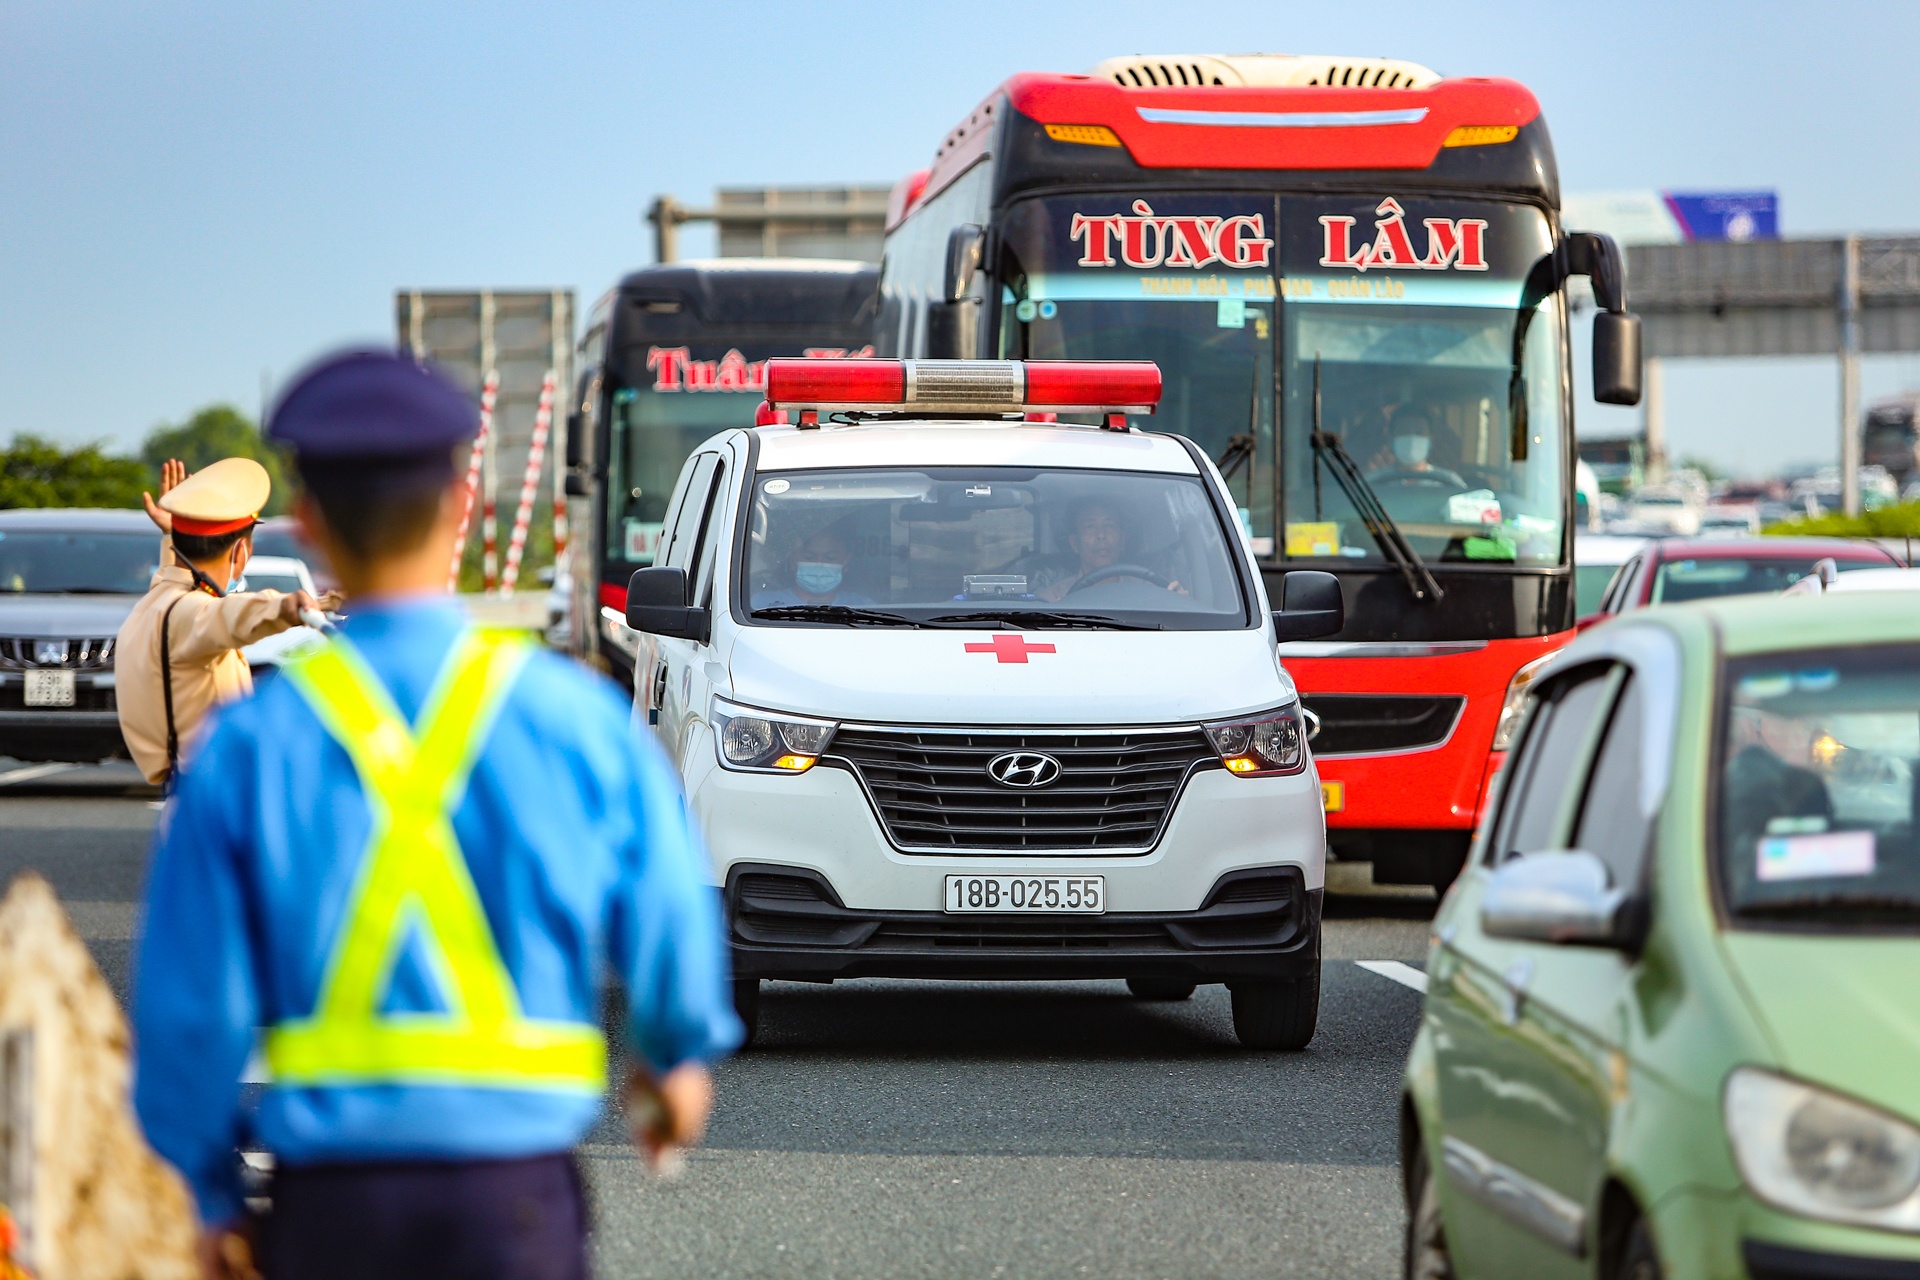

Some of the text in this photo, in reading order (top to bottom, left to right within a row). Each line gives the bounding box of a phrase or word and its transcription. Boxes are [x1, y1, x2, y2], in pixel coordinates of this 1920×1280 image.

[1071, 197, 1489, 271] TÙNG LÂM
[1140, 277, 1193, 295] THANH
[953, 879, 1099, 908] 18B-025.55
